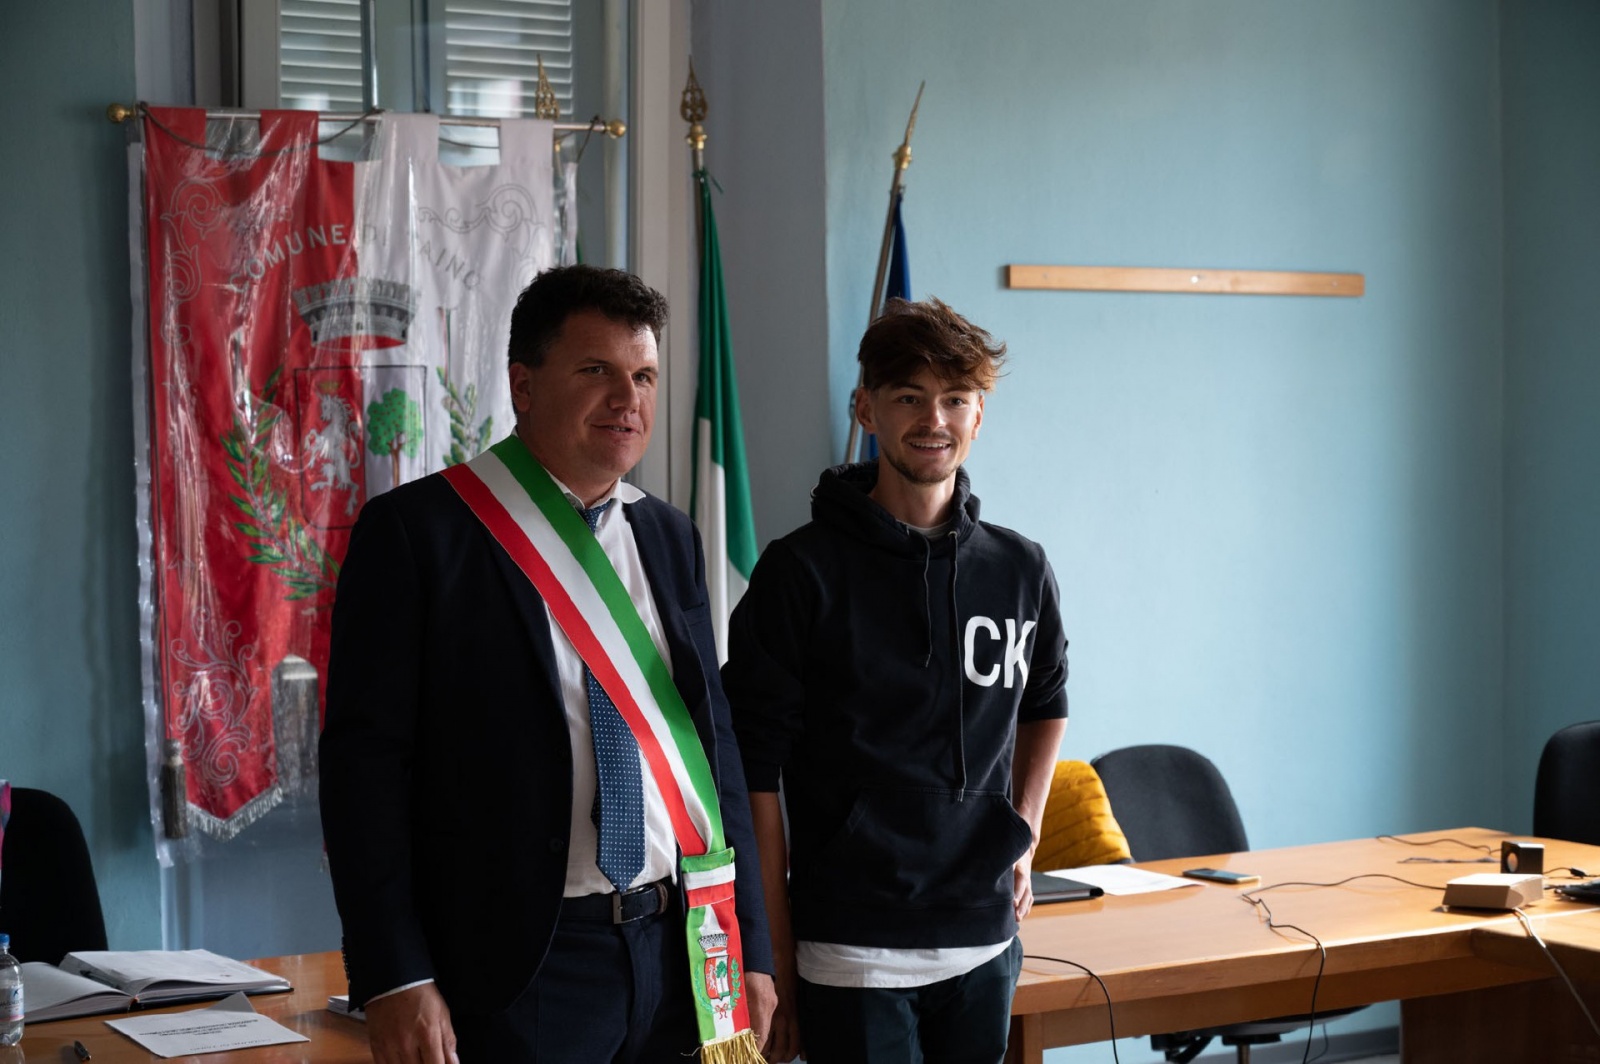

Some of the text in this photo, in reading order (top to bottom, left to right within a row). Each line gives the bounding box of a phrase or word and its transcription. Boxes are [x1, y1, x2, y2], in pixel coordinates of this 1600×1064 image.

[229, 223, 346, 293] COMUNE
[363, 224, 388, 246] DI
[964, 615, 1037, 690] CK
